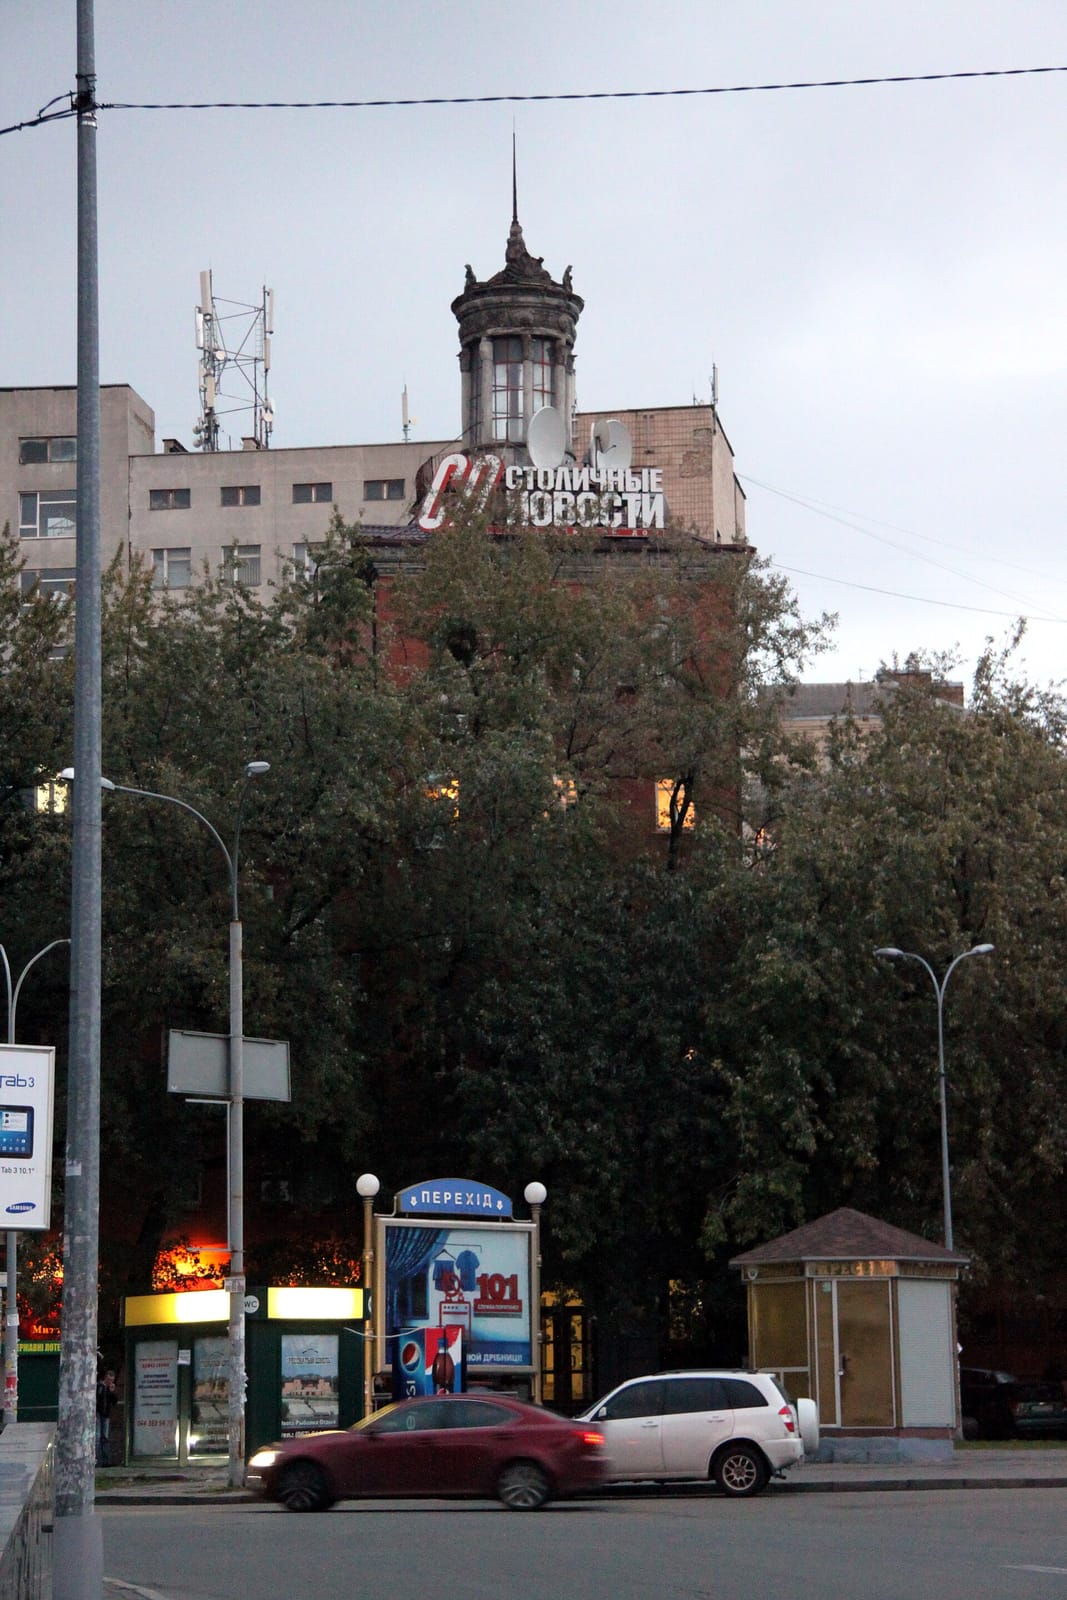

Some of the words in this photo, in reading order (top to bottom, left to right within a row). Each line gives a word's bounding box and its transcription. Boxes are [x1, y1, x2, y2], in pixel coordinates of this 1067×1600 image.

[506, 466, 662, 492] СТОЛИЧНЫЕ
[421, 1190, 492, 1209] ПЕРЕХІД
[476, 1272, 518, 1300] 101
[244, 1300, 258, 1309] WC
